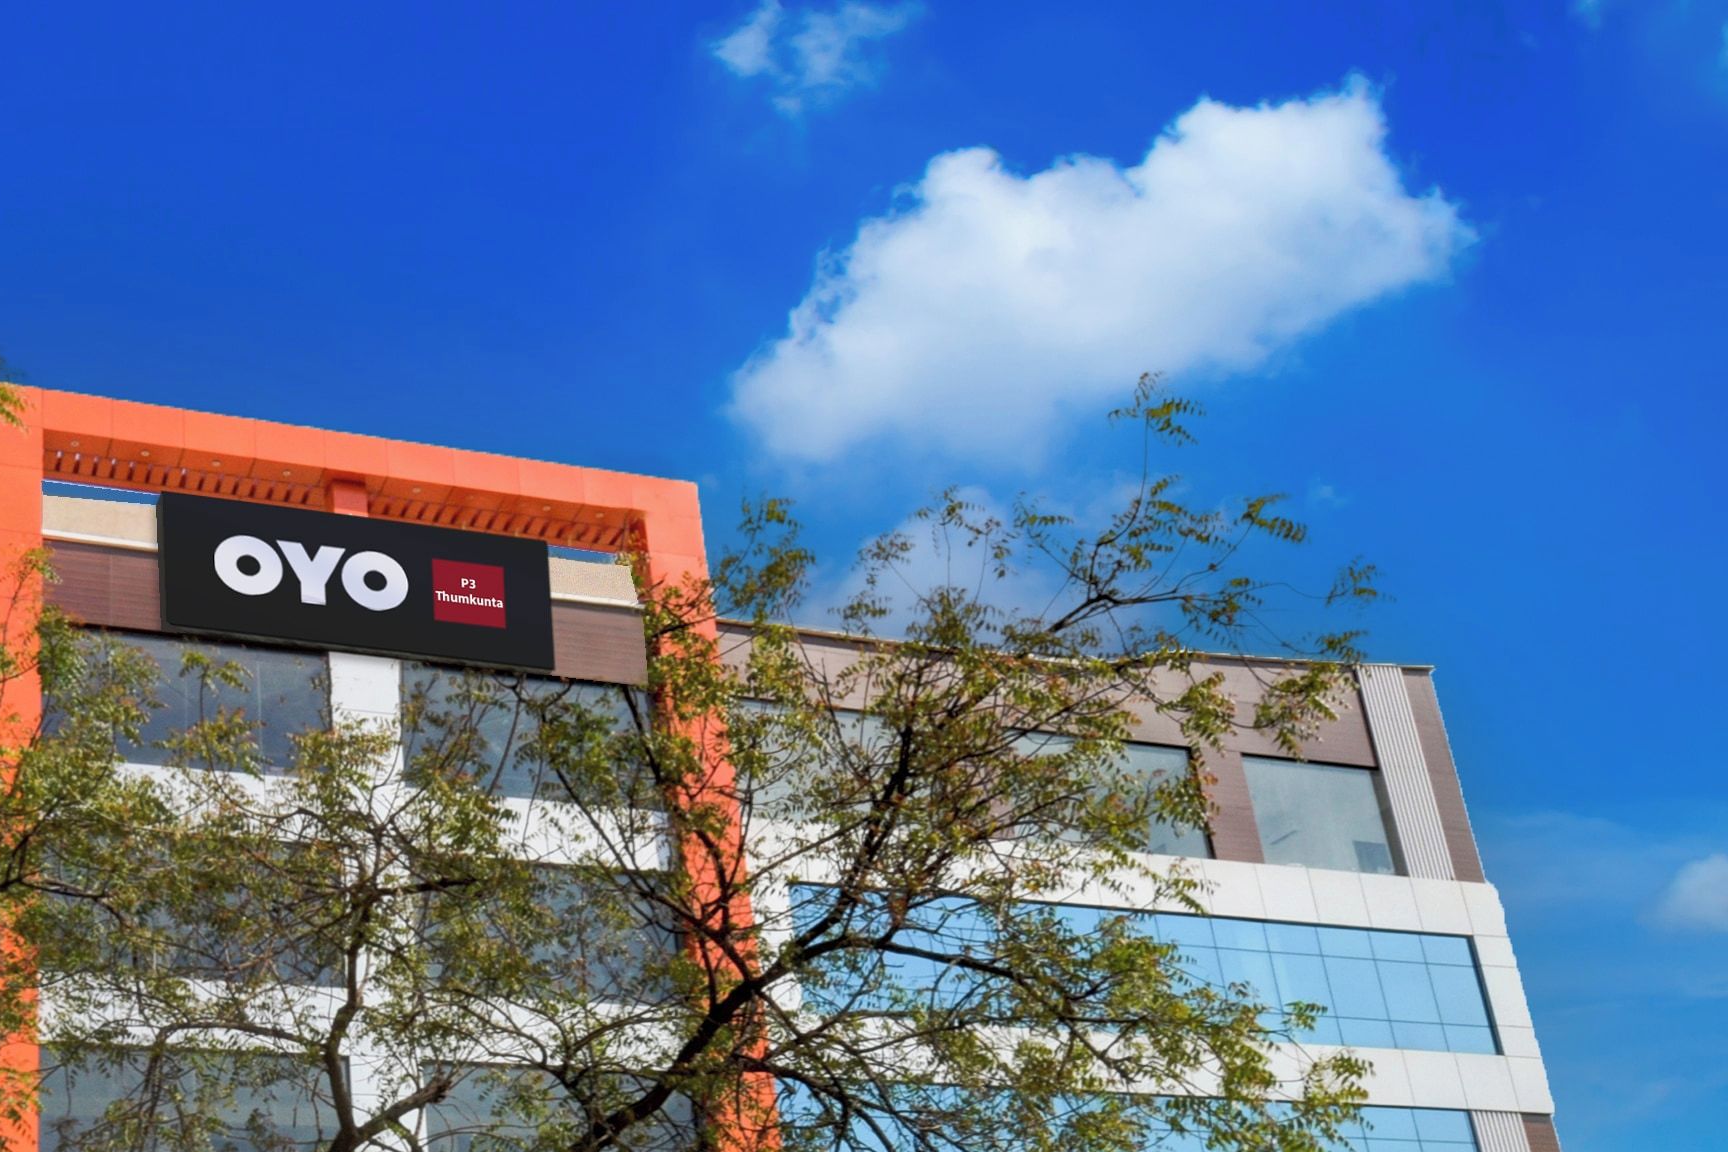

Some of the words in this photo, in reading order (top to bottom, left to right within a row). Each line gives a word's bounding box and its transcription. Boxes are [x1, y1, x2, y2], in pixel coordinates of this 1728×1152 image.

[214, 535, 409, 611] OYO
[460, 577, 476, 589] P3
[435, 590, 504, 608] Thumkunta
